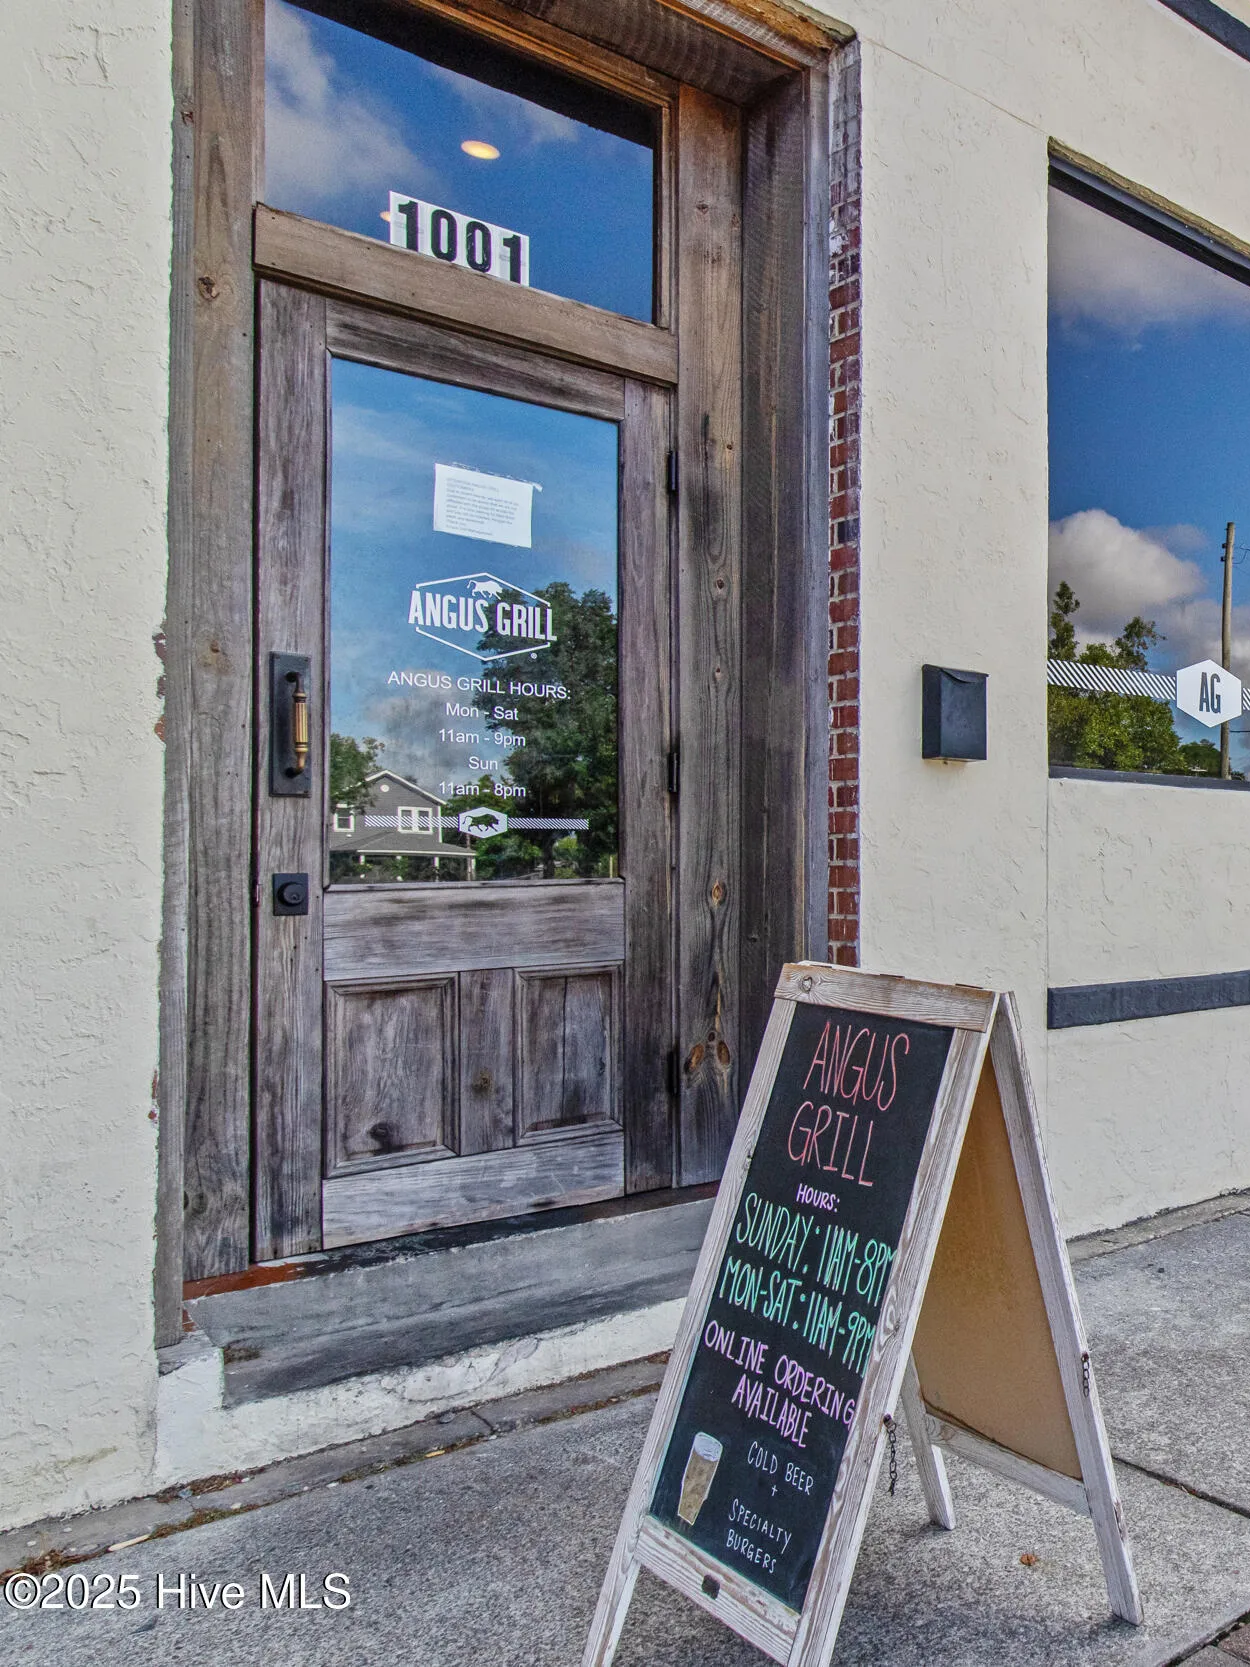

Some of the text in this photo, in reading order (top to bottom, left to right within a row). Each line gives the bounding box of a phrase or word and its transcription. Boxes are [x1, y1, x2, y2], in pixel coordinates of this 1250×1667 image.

[398, 200, 521, 284] 1001
[408, 590, 558, 641] ANGUS GRILL
[387, 671, 571, 700] ANGUS GRILL HOURS:
[1198, 671, 1221, 714] AG
[446, 703, 479, 717] Mon
[493, 706, 518, 720] Sat
[439, 728, 479, 744] 11am
[494, 732, 526, 748] 9pm
[468, 756, 498, 770] Sun
[439, 781, 479, 796] 11am
[494, 783, 526, 800] 8pm
[803, 1021, 909, 1111] ANGUS
[788, 1101, 873, 1187] GRILL
[796, 1183, 840, 1212] HOURS:
[704, 1320, 855, 1431] ONLINE ORDERING
[731, 1373, 812, 1448] AVAILABLE
[747, 1441, 814, 1496] COLD BEER
[729, 1499, 792, 1554] SPECIALTY
[726, 1529, 777, 1574] BURGERS
